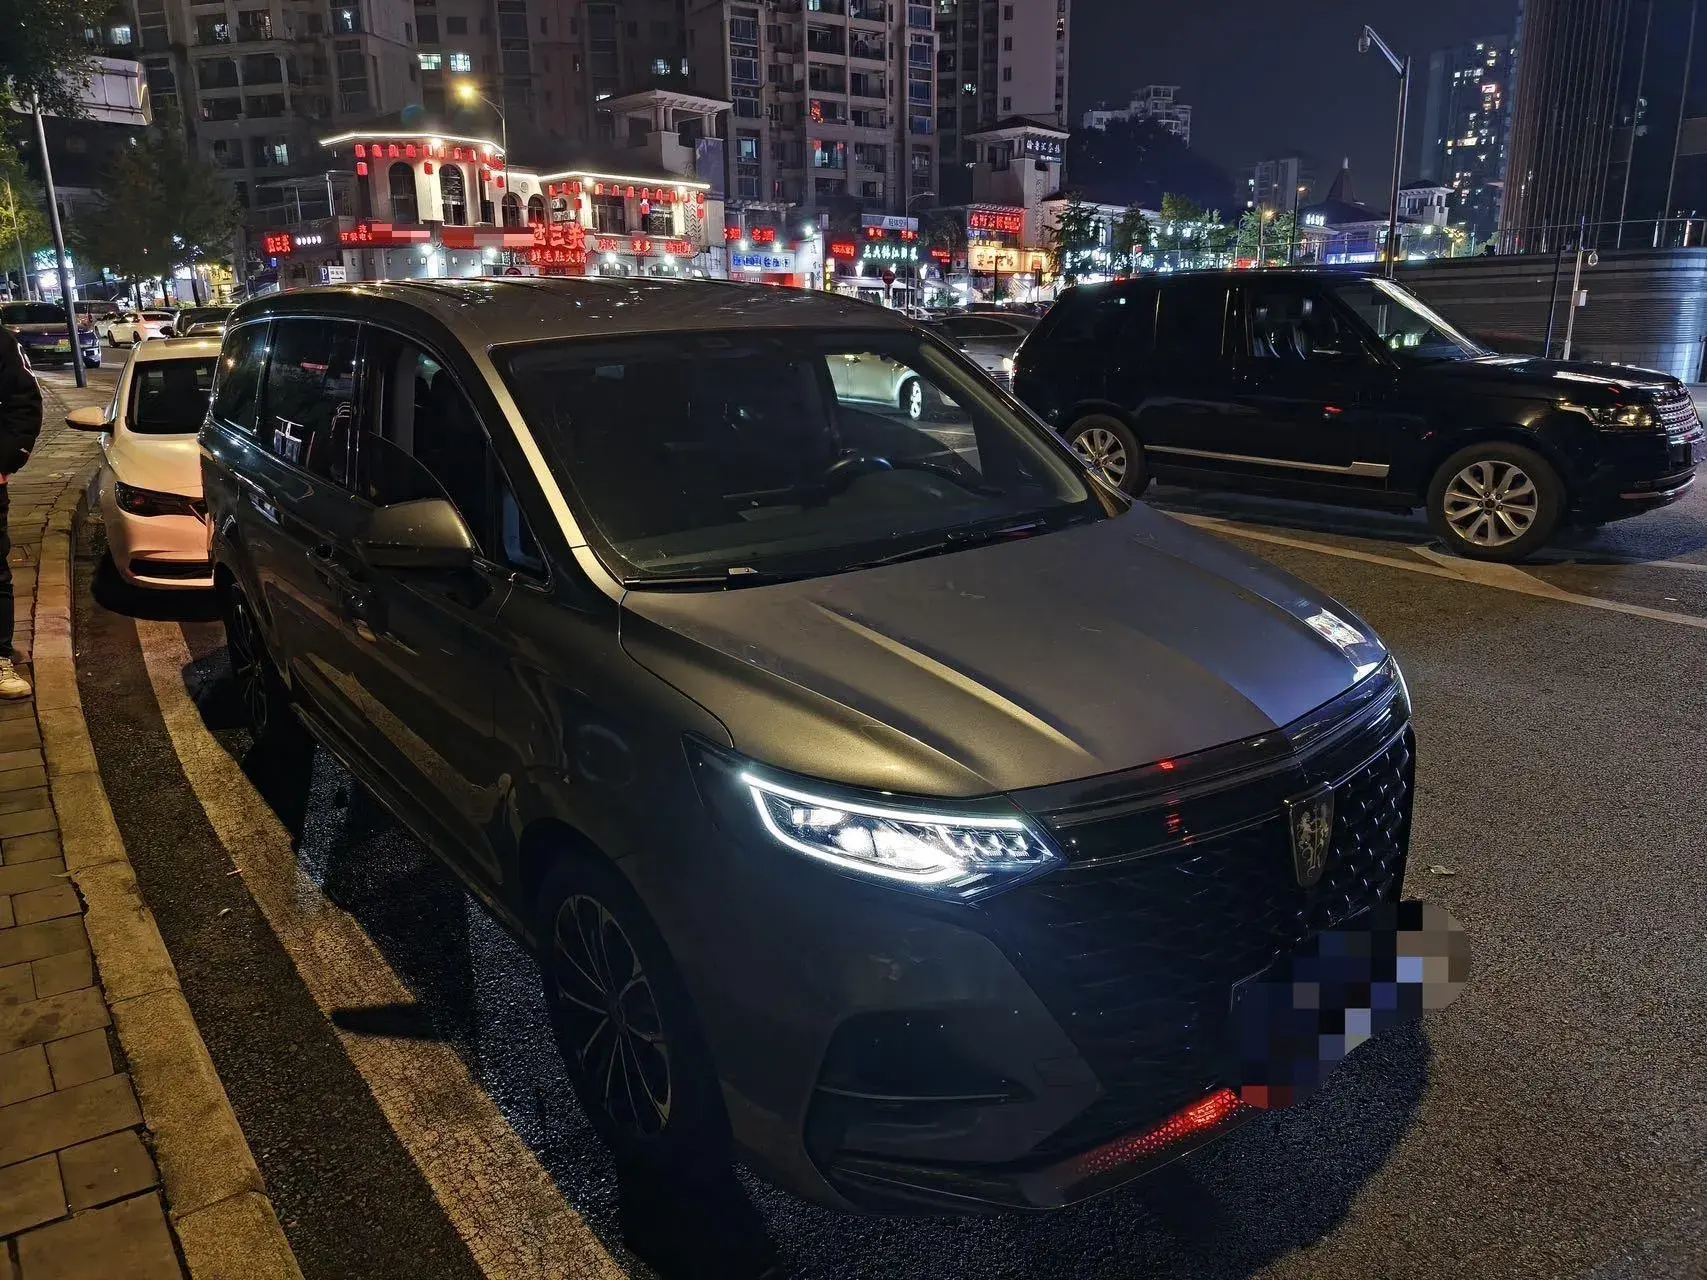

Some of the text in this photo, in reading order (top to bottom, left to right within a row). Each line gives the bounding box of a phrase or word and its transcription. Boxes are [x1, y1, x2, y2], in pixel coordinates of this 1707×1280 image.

[752, 228, 774, 241] 名酒
[531, 249, 587, 263] 鲜毛肚火锅
[321, 267, 328, 284] P
